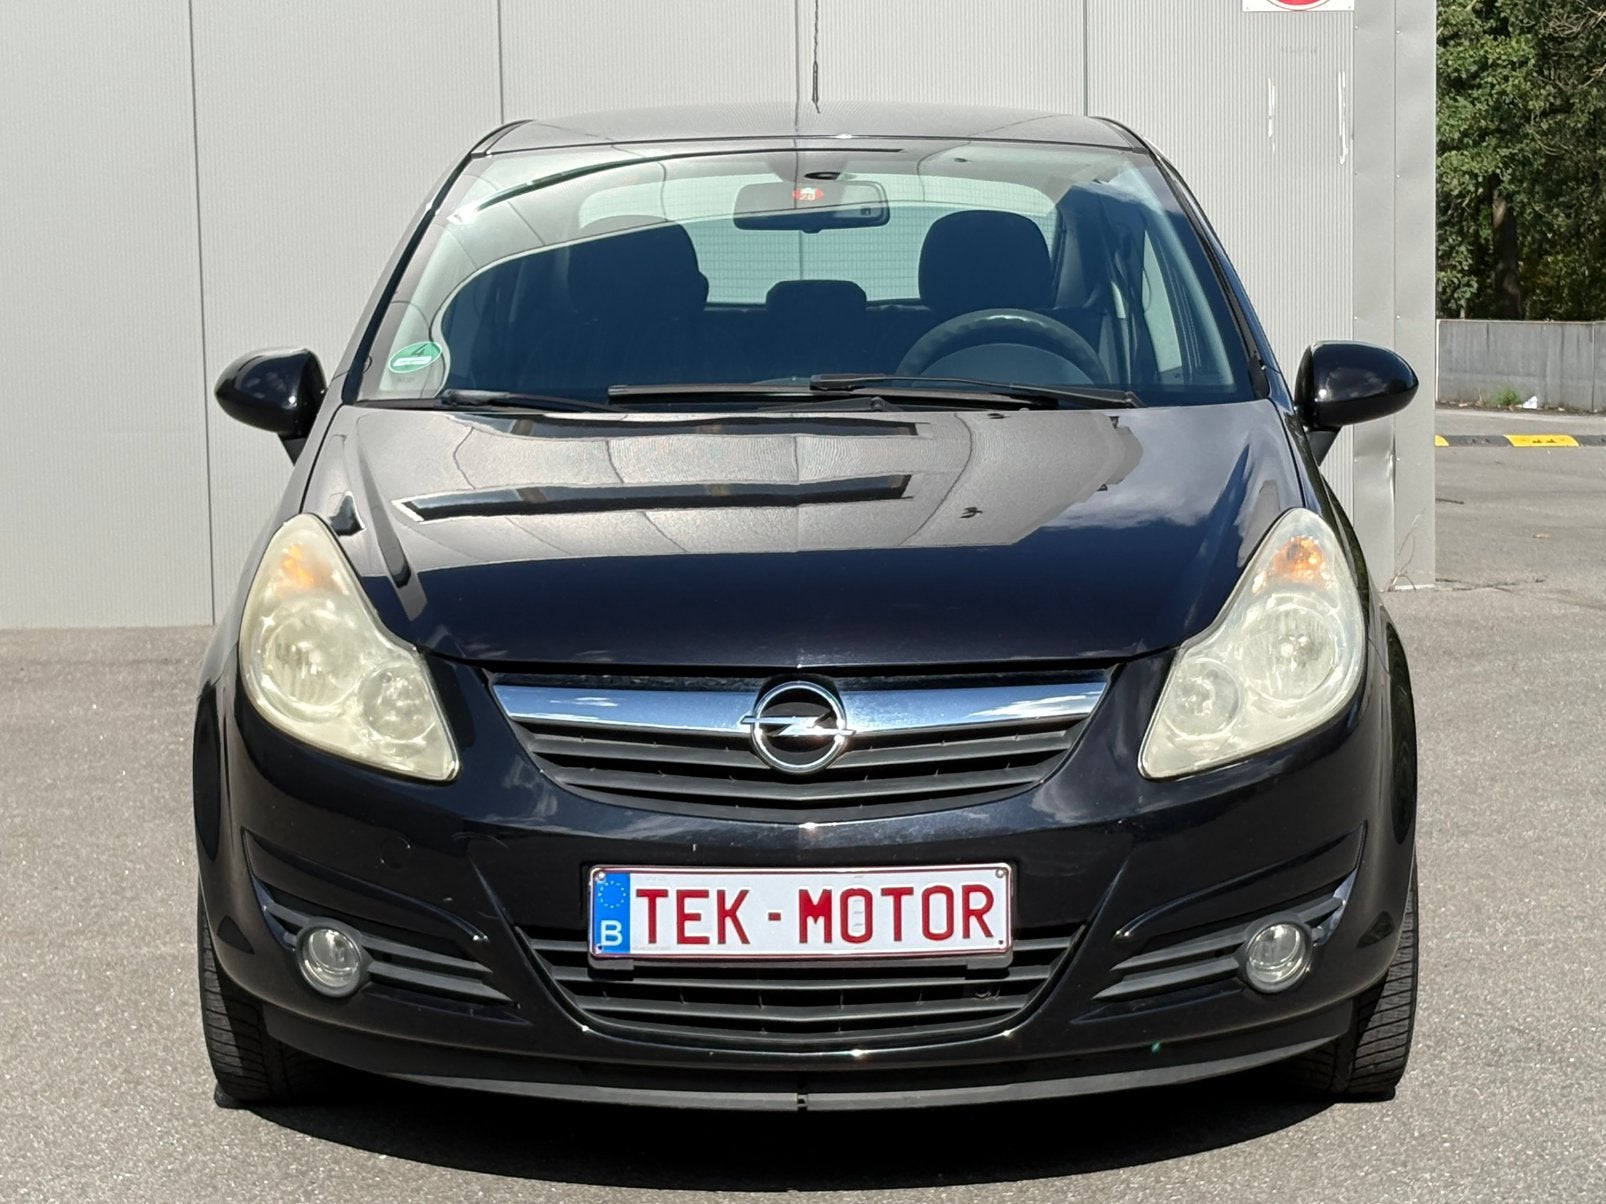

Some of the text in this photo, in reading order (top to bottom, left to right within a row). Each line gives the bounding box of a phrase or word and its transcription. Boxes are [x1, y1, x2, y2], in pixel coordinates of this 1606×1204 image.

[411, 343, 426, 357] 4
[635, 888, 750, 945] TEK
[798, 884, 995, 944] MOTOR
[600, 919, 623, 946] B
